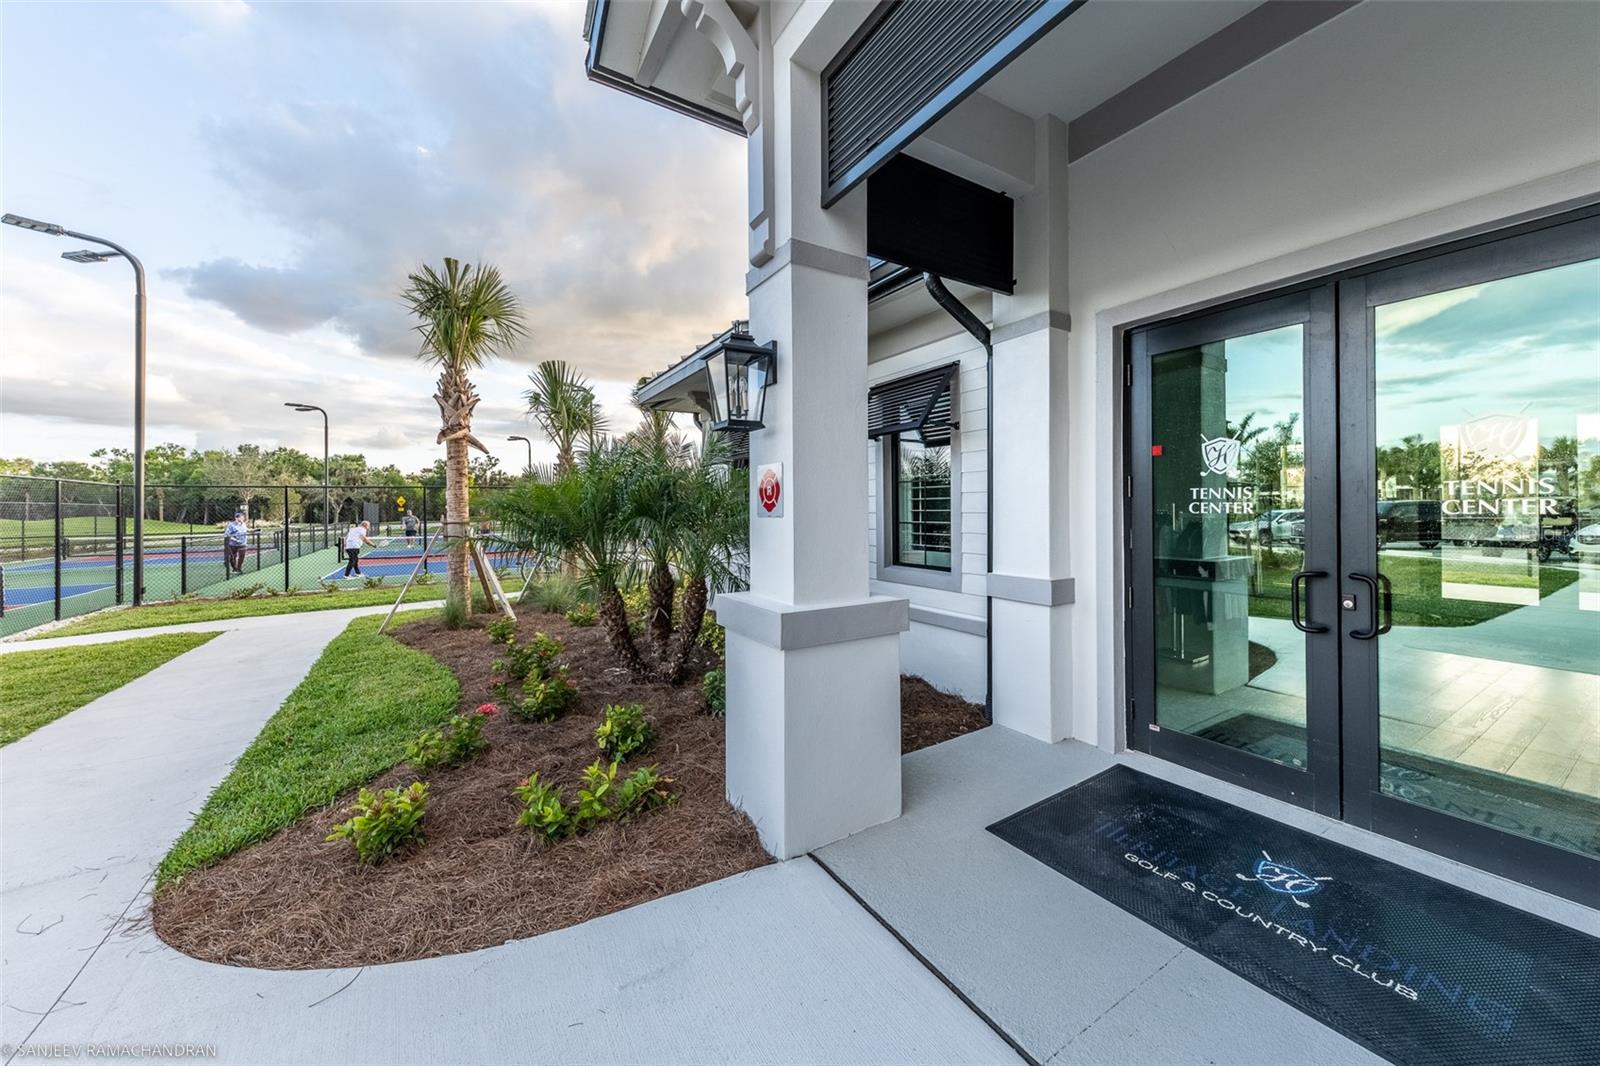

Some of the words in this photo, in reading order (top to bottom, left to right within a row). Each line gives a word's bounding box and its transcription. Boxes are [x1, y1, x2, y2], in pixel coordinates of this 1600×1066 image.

[1189, 486, 1252, 500] TENNIS
[1443, 477, 1555, 496] TENNIS
[1188, 501, 1254, 514] CENTER
[1441, 498, 1559, 515] CENTER
[1124, 852, 1181, 881] GOLF
[1181, 880, 1197, 893] &
[1201, 890, 1328, 953] COUNTRY
[1331, 953, 1419, 1002] CLUB
